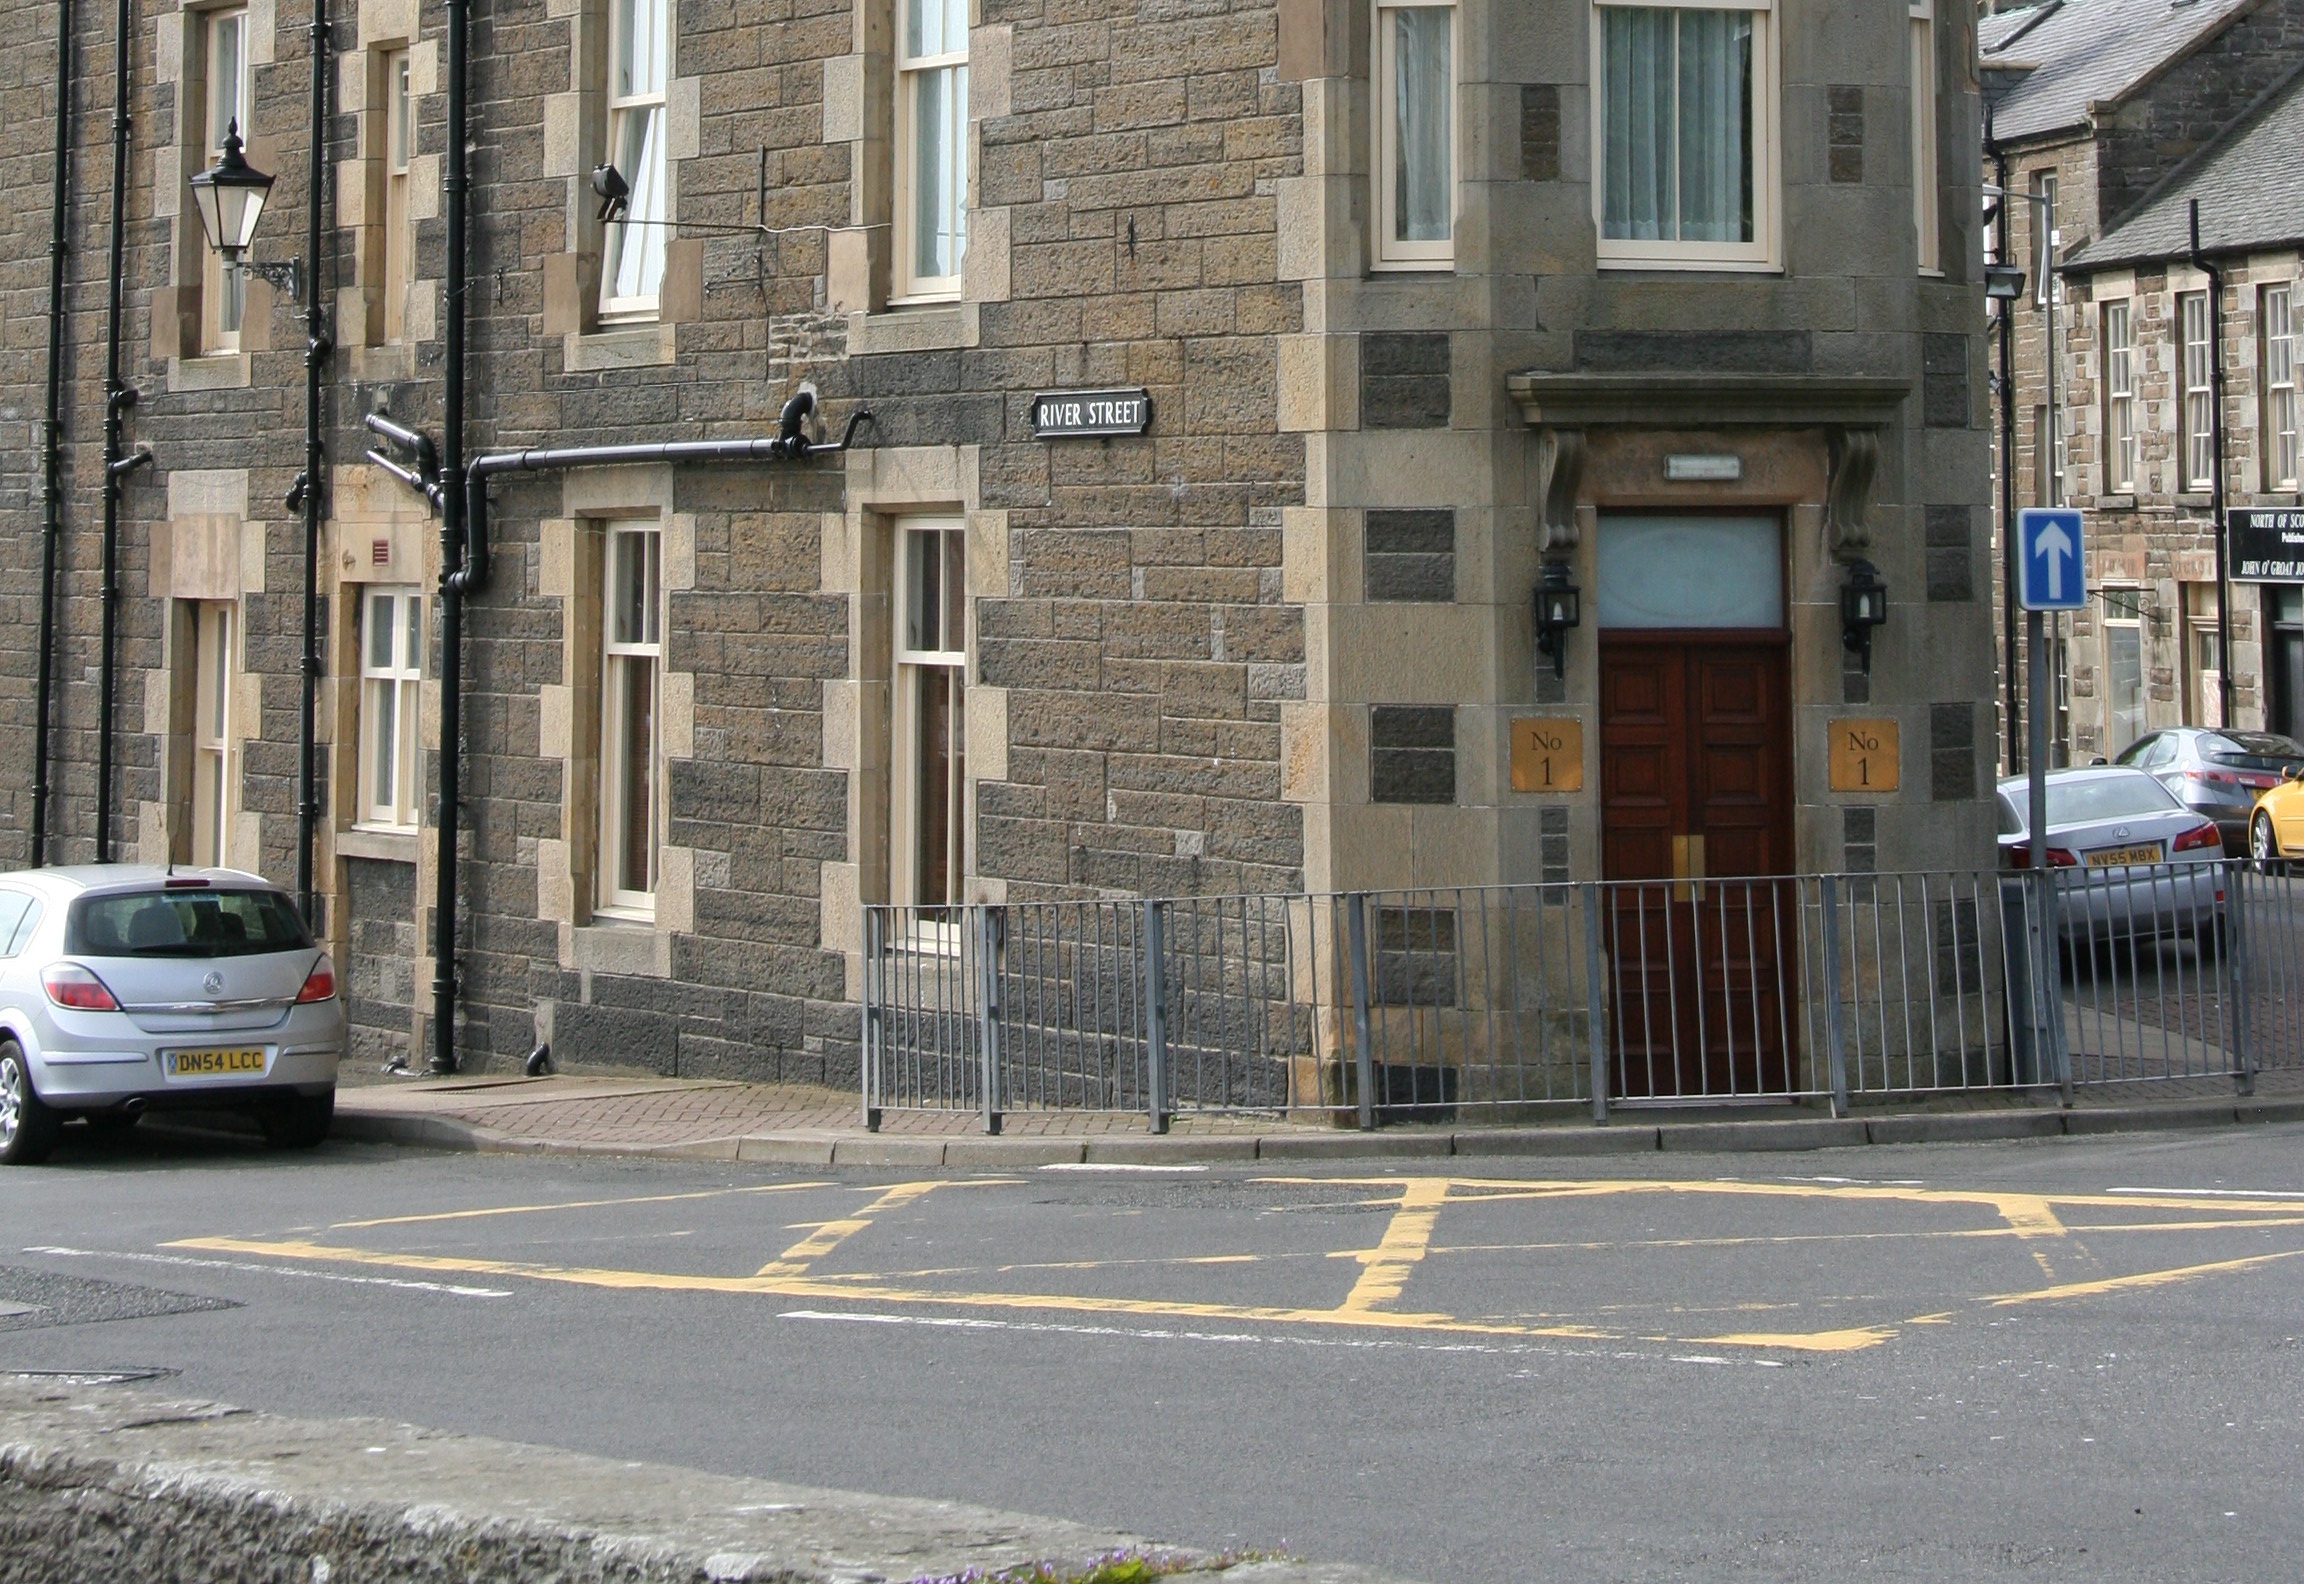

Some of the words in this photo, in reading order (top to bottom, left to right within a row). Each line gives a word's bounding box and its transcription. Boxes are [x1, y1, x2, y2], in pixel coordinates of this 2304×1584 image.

[1040, 403, 1082, 427] RIVER
[1089, 400, 1141, 424] STREET
[2250, 514, 2275, 528] NORTH
[2277, 514, 2288, 528] OF
[2241, 561, 2261, 575] JOHN
[2261, 559, 2270, 575] O'
[2270, 560, 2294, 576] GROAT
[1530, 731, 1563, 751] No
[1847, 731, 1879, 751] No
[1540, 756, 1553, 786] 1
[1857, 756, 1870, 786] 1
[2128, 849, 2155, 862] MBX
[179, 1053, 225, 1071] DN54
[229, 1052, 263, 1069] LCC
